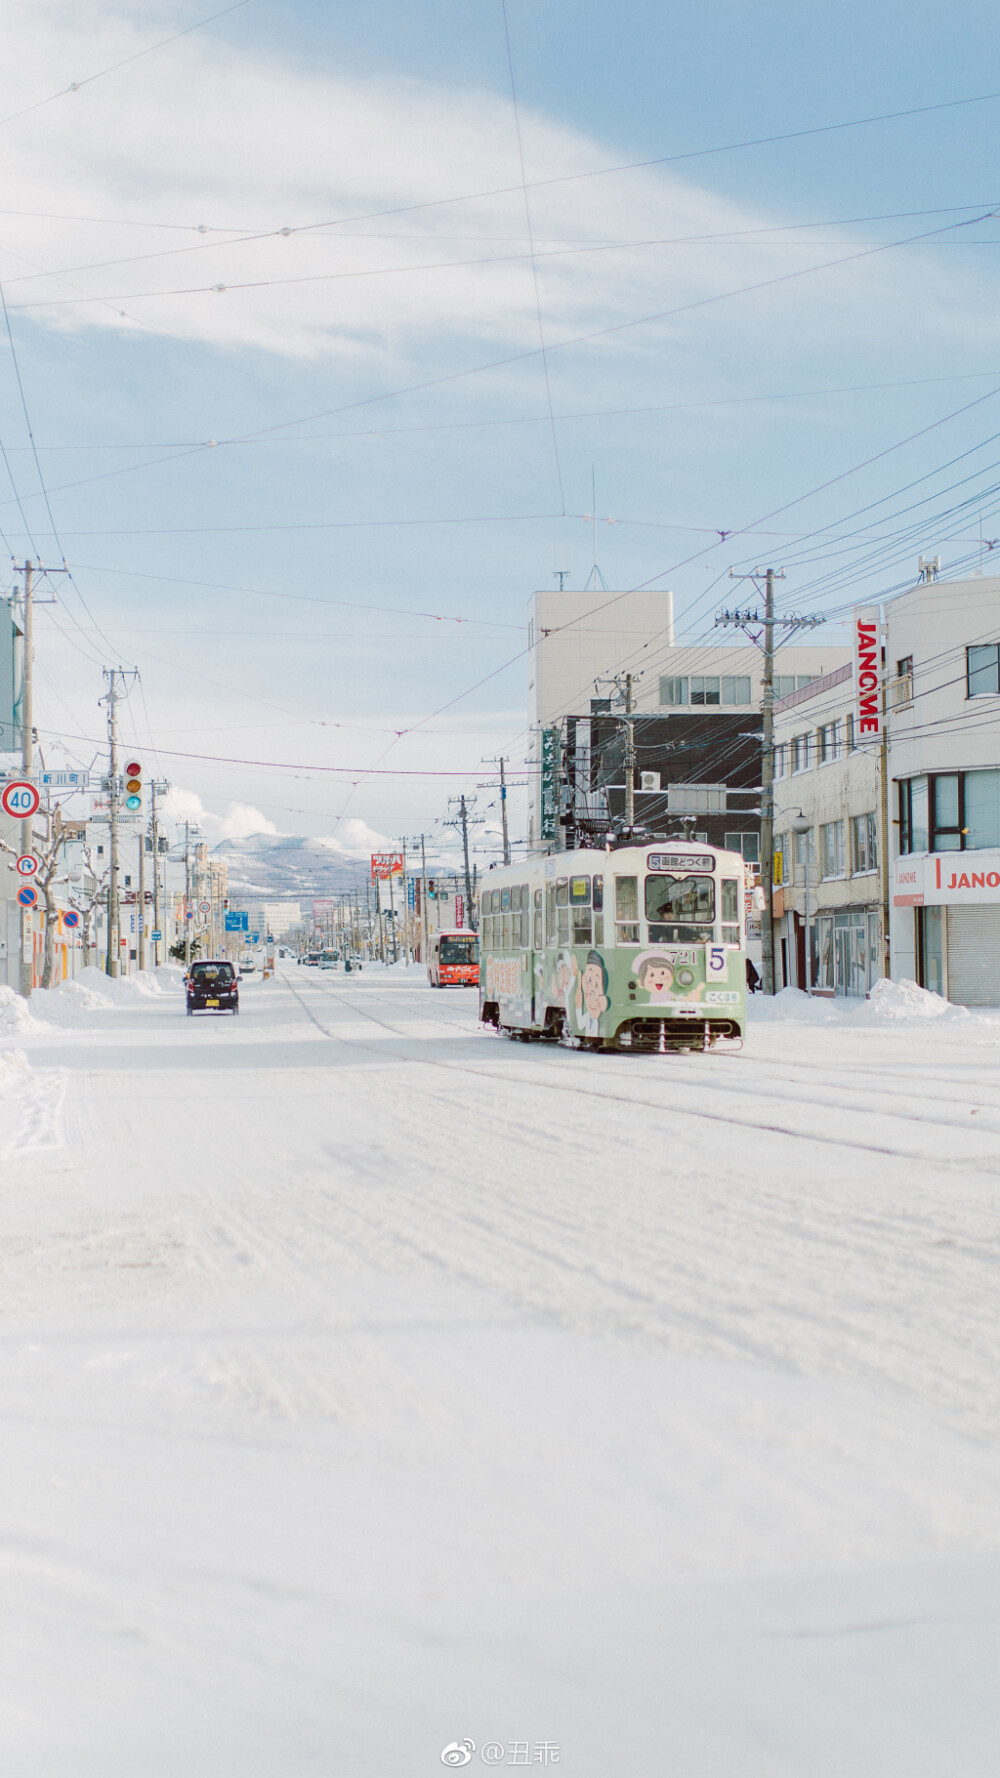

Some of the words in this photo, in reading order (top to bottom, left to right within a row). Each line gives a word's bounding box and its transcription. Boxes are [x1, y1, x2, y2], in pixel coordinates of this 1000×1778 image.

[857, 617, 879, 733] JANOME
[11, 792, 31, 809] 40
[899, 871, 916, 884] JANOME
[669, 951, 698, 965] 721
[710, 947, 725, 971] 5
